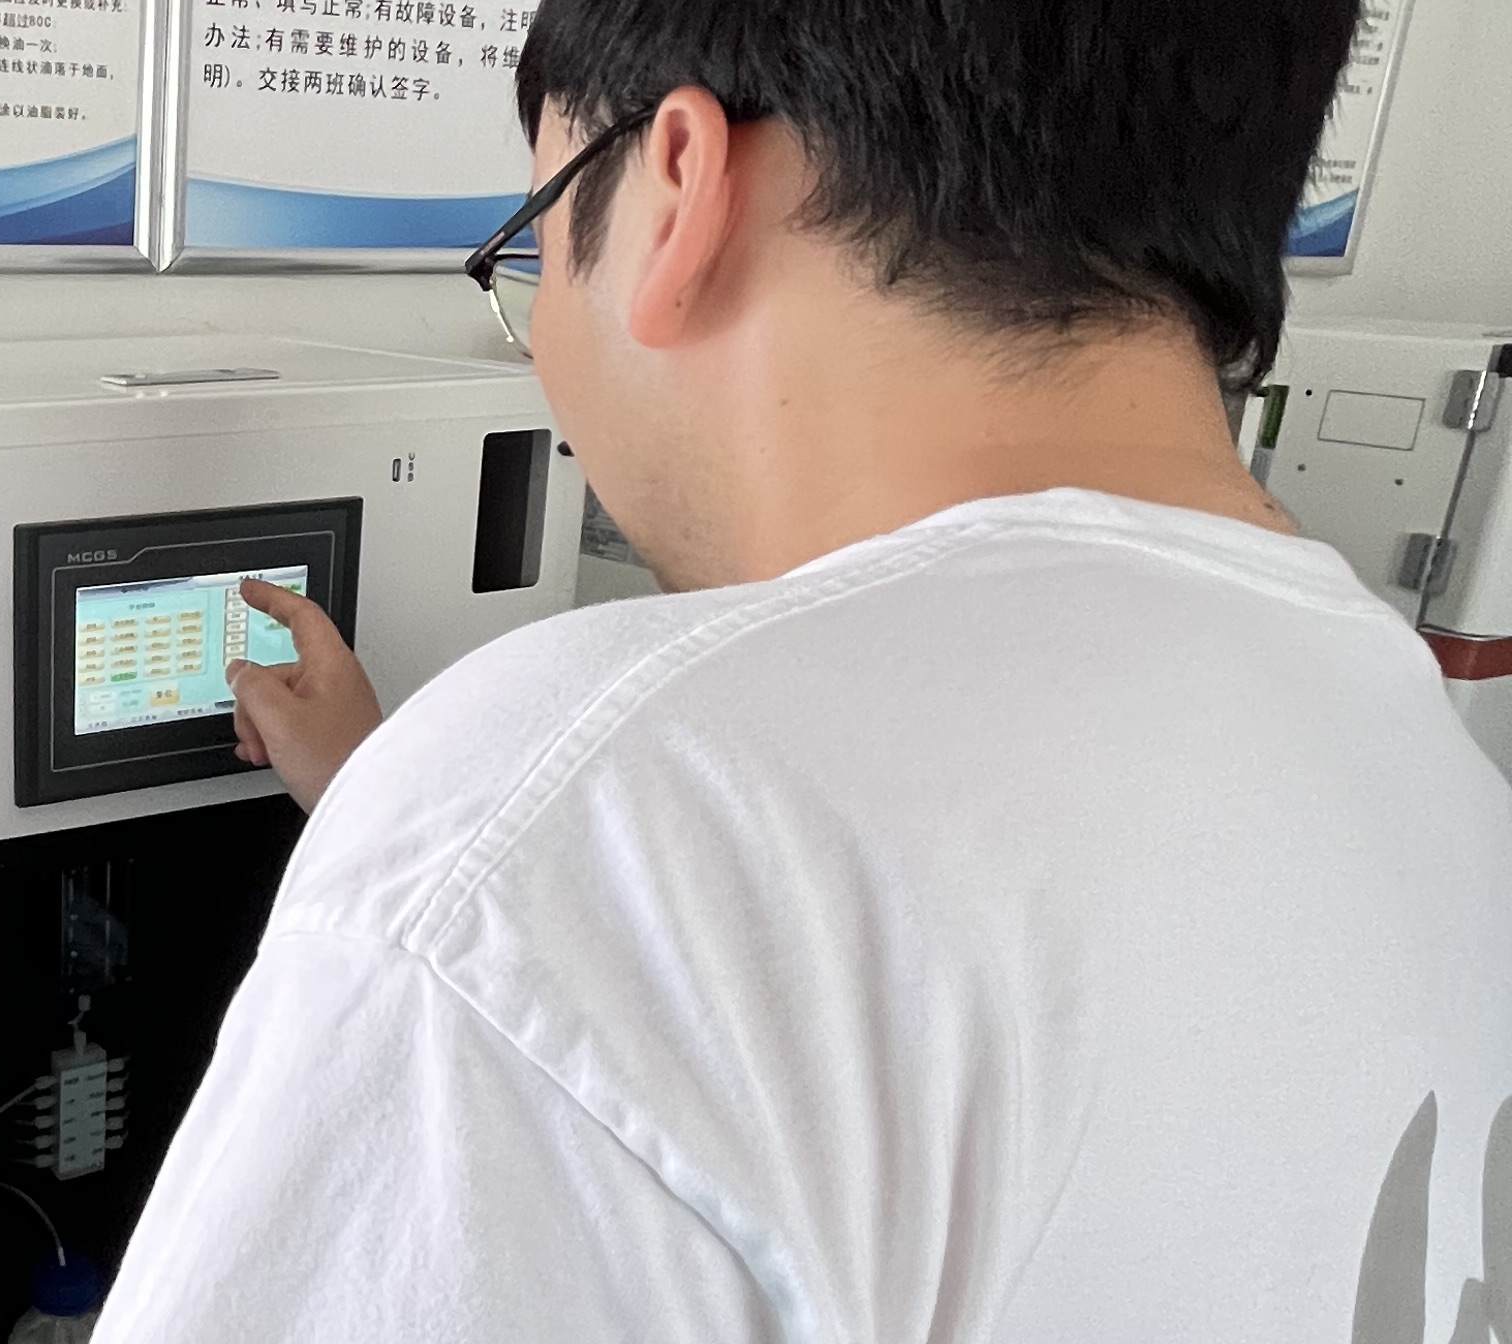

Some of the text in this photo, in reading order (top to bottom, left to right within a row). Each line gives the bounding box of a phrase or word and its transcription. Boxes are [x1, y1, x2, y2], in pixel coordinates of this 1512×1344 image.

[202, 62, 440, 102] 明)。交接两班确认签字。
[67, 549, 118, 563] MCGS
